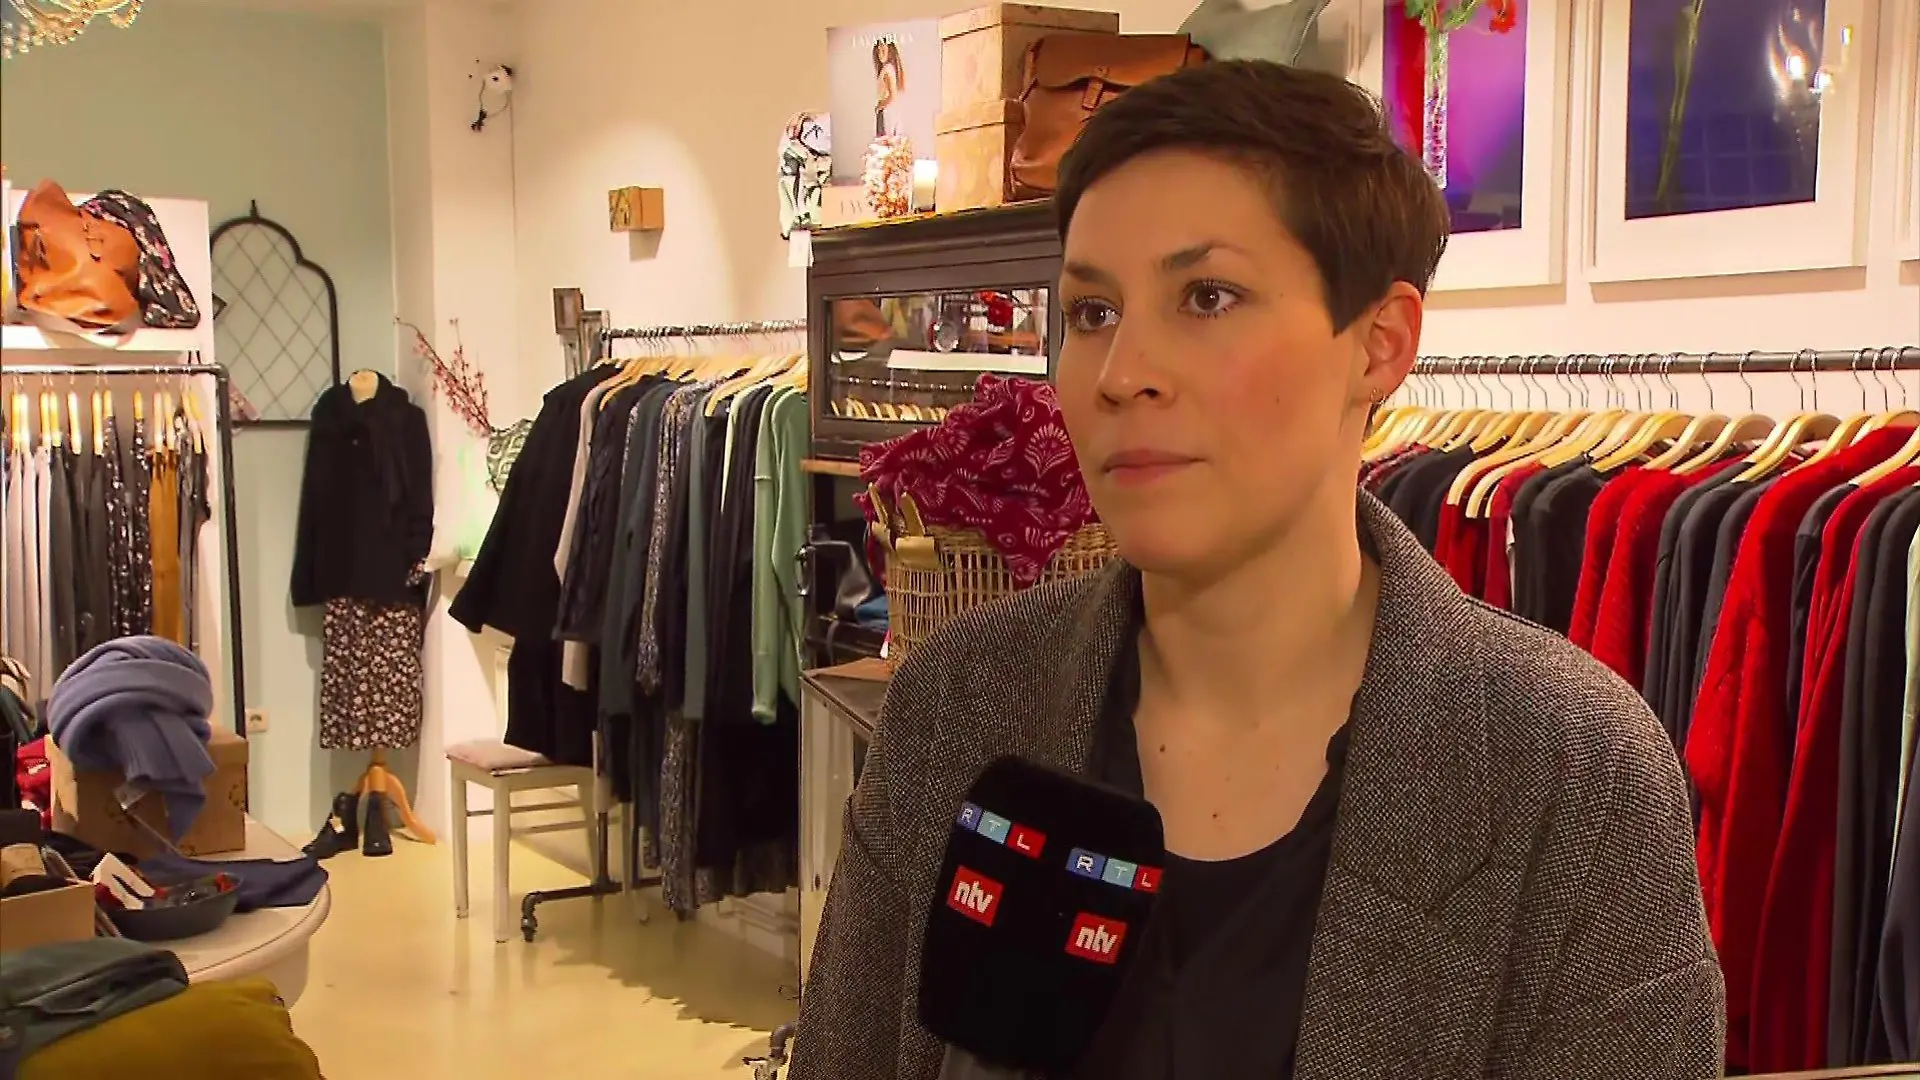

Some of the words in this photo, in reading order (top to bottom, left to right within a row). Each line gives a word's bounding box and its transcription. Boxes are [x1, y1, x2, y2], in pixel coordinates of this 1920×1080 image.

[961, 807, 1031, 850] RTL
[1076, 855, 1153, 888] RTL
[954, 880, 994, 914] ntv
[1075, 924, 1118, 954] ntv
